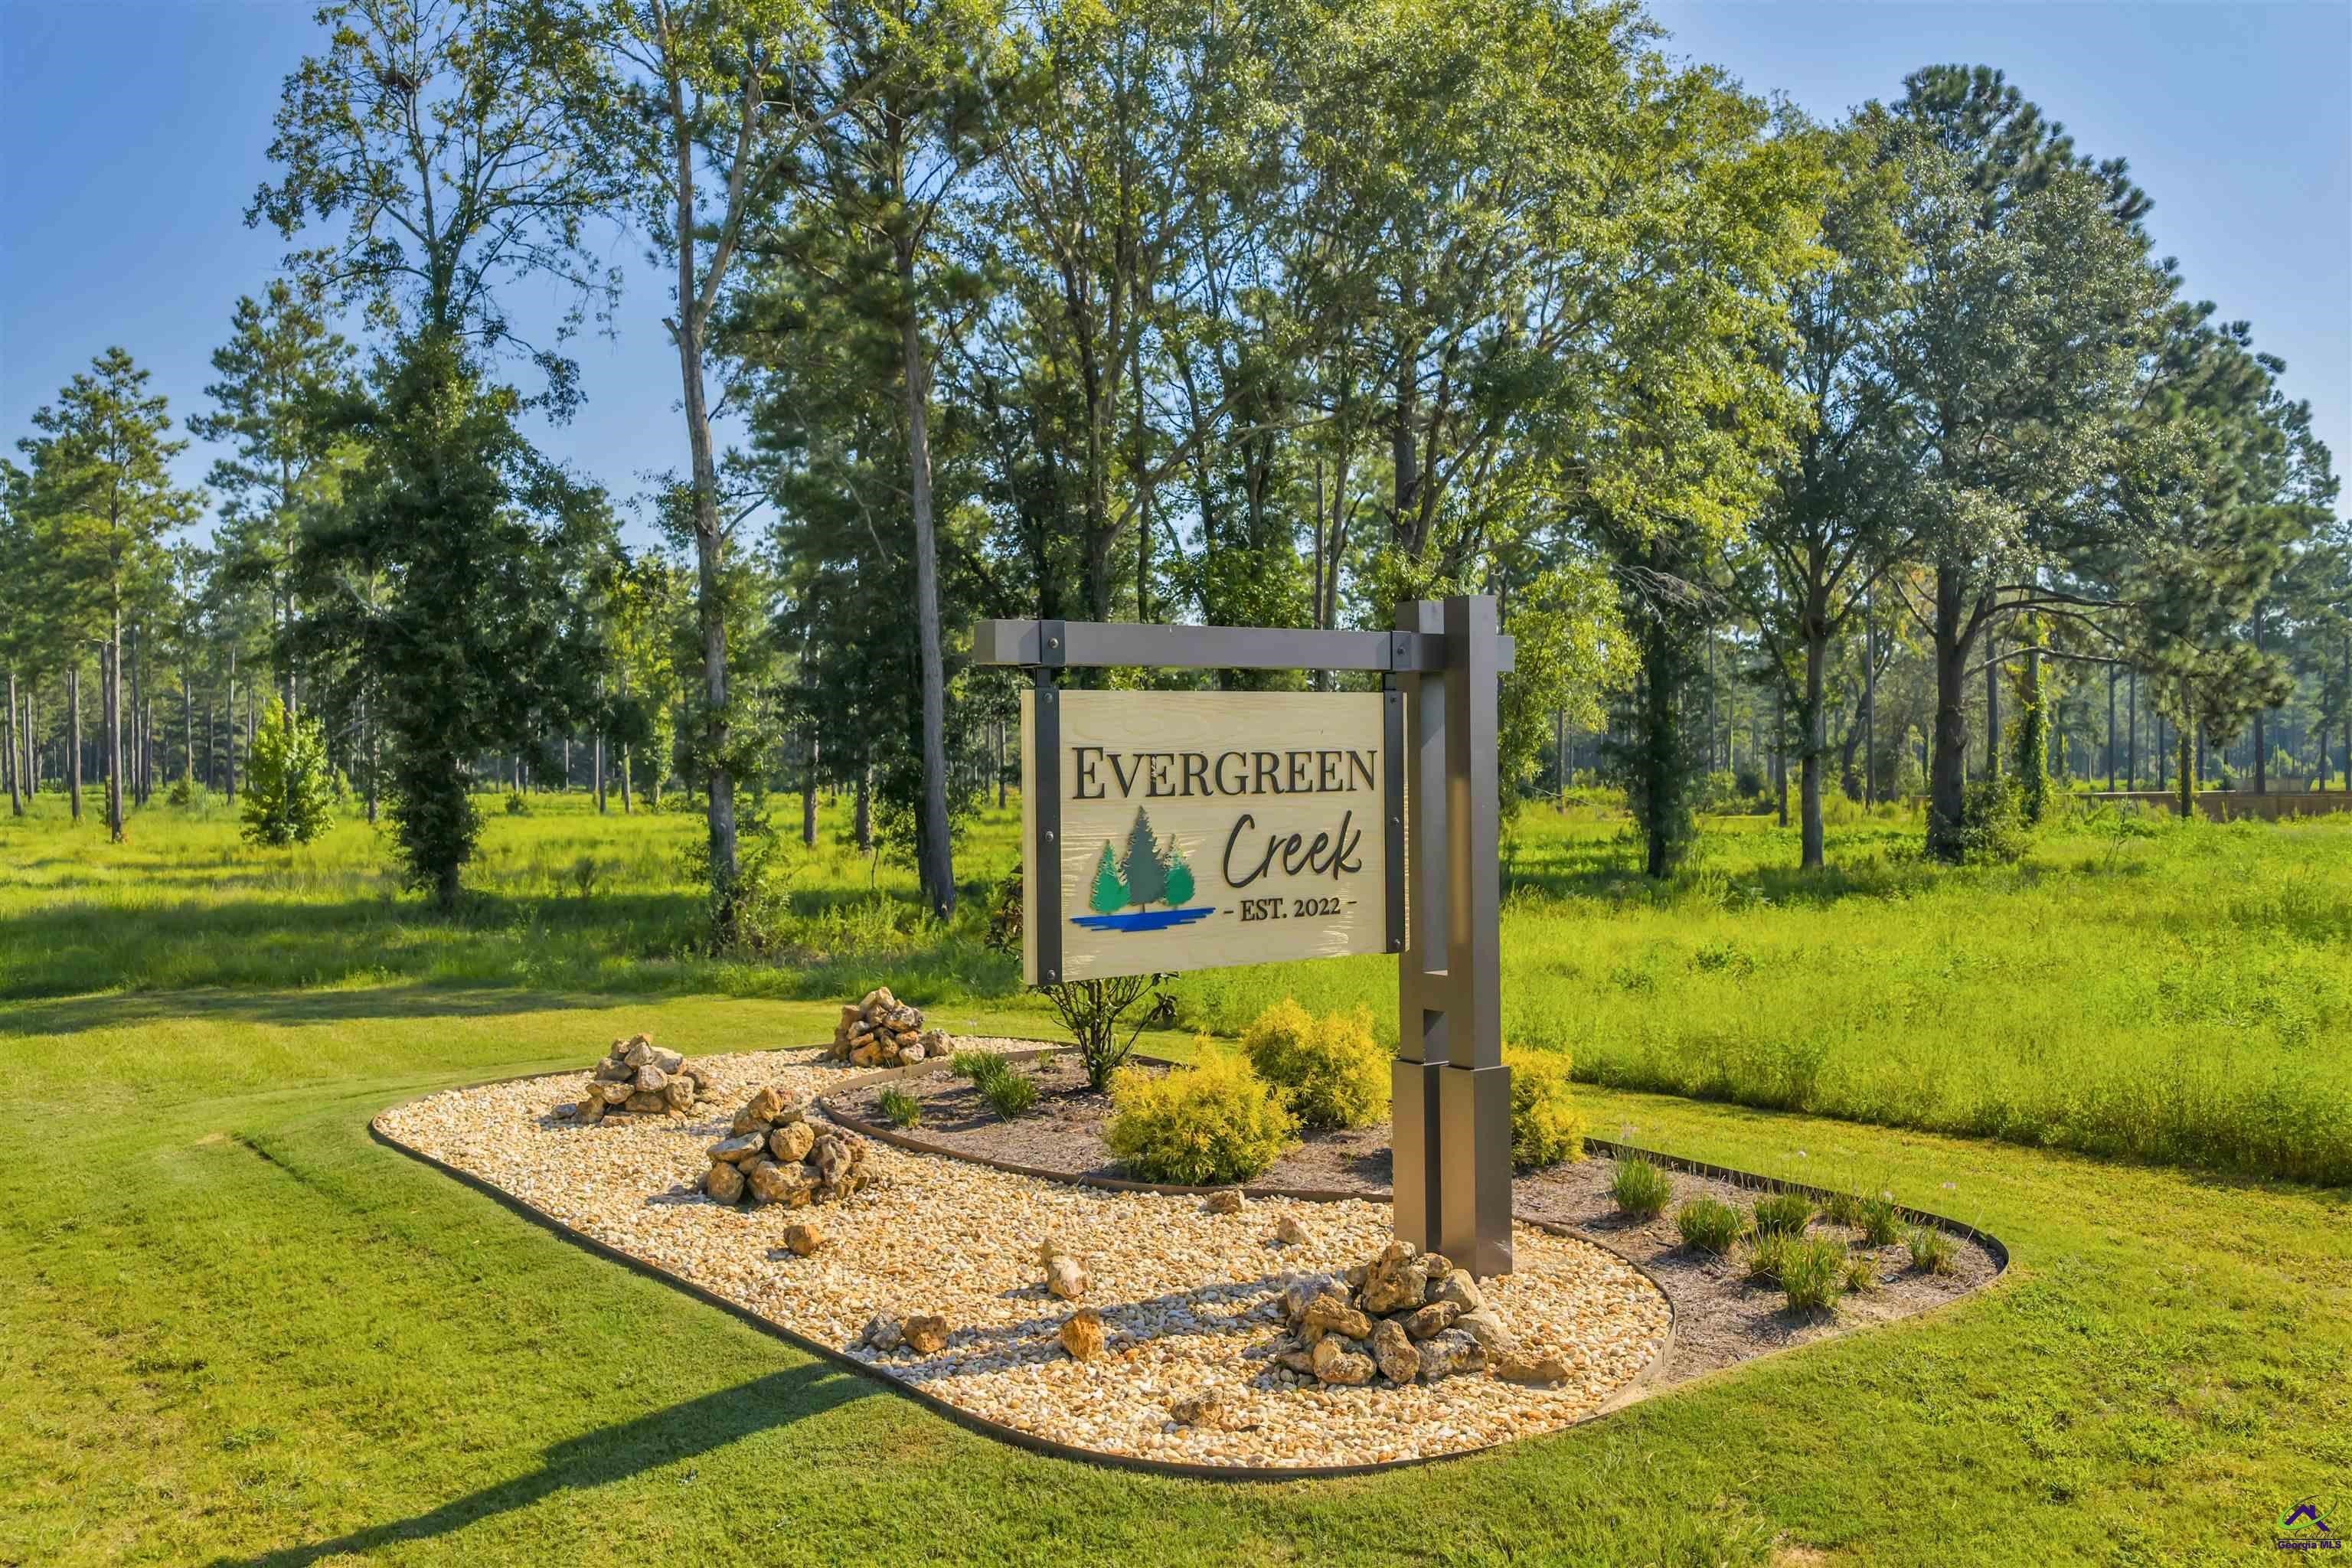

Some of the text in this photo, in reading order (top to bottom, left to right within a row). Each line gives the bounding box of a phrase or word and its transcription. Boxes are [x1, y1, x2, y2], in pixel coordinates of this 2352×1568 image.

[1072, 747, 1377, 799] EVERGREEN
[1223, 810, 1362, 889] Creek
[1240, 898, 1341, 923] EST. 2022
